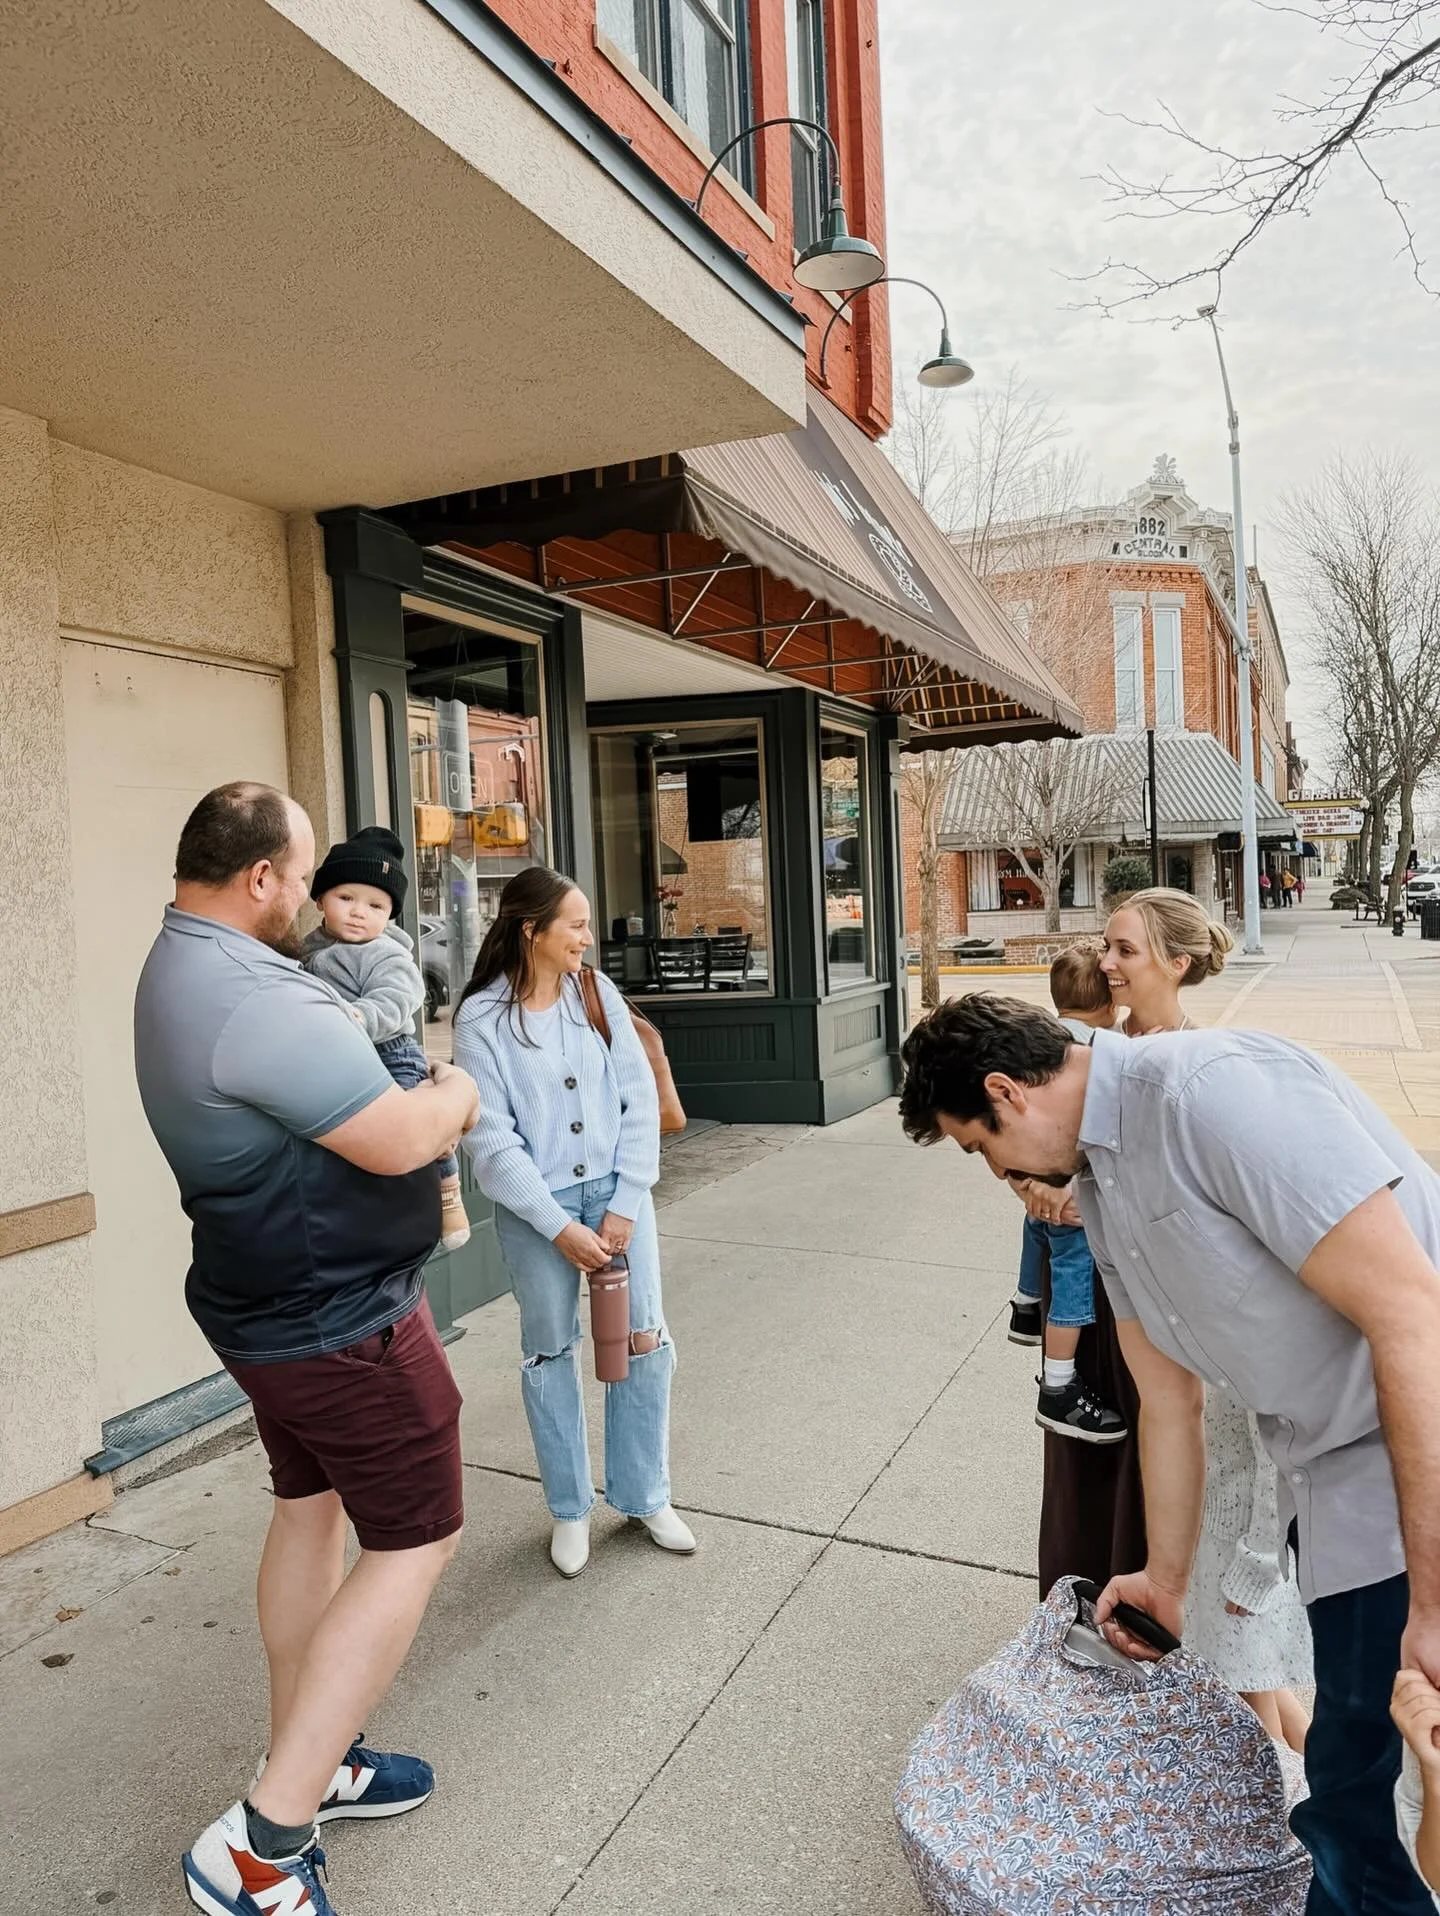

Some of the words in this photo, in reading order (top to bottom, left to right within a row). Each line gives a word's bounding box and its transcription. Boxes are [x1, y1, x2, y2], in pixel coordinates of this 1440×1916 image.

[1135, 517, 1166, 536] 1882
[1124, 538, 1175, 558] CENTRAL
[1137, 550, 1164, 558] BLOCK
[450, 771, 488, 799] OPEN
